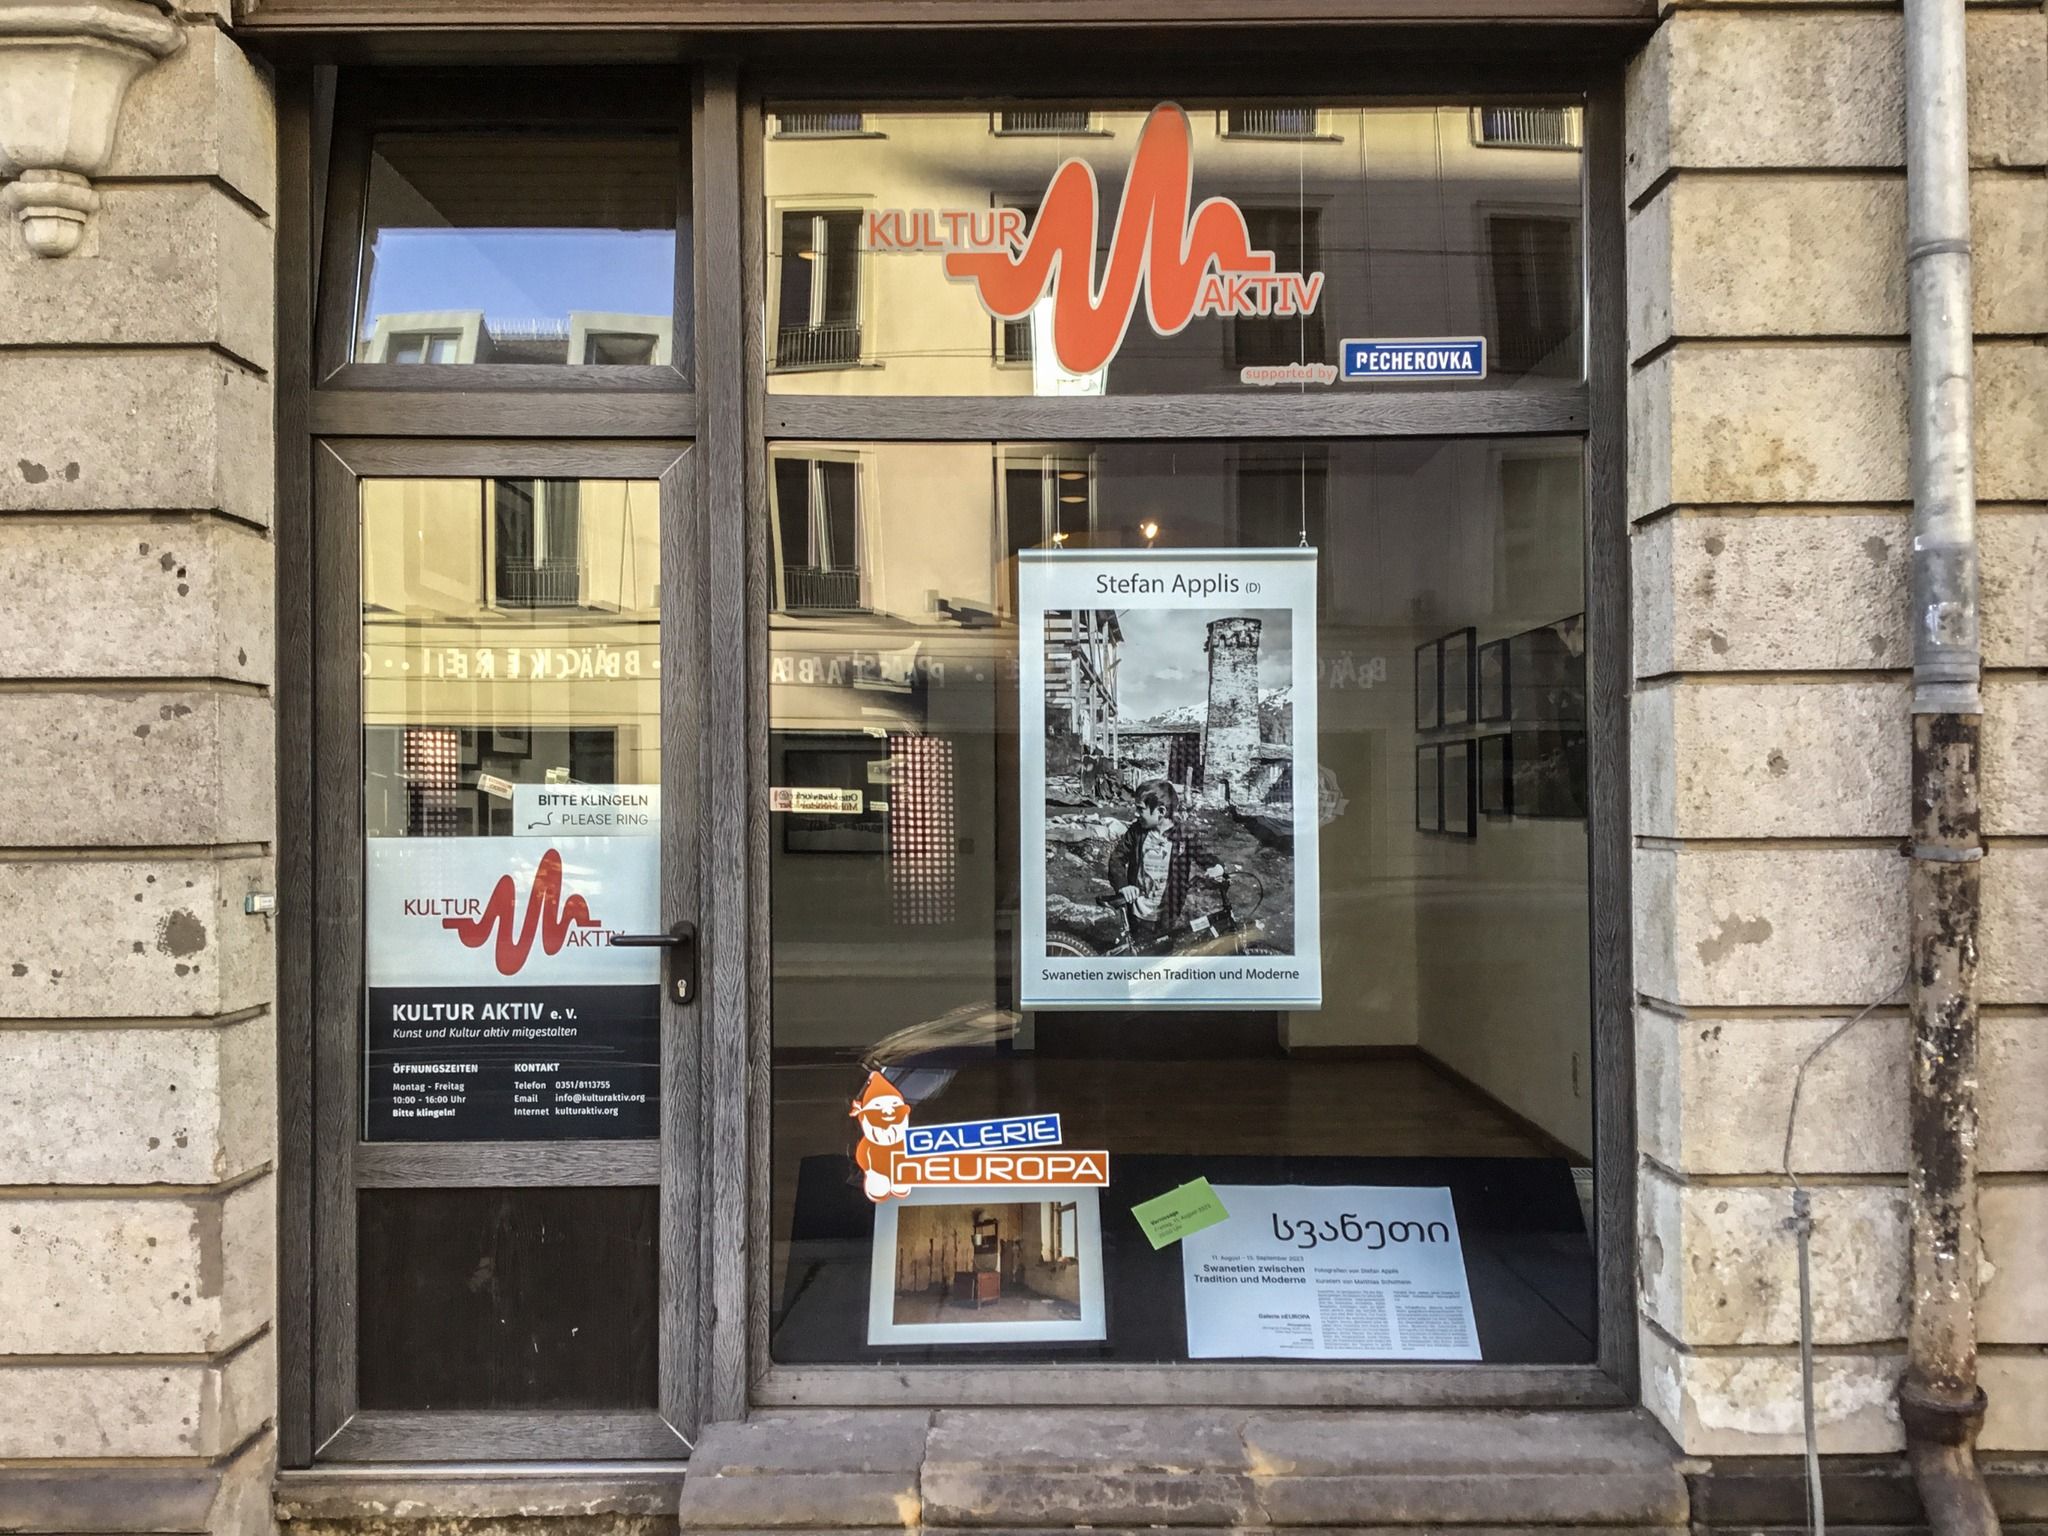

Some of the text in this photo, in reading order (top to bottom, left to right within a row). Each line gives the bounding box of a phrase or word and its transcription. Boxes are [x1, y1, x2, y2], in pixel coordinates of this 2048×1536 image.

[869, 210, 1026, 248] KULTUR
[1201, 273, 1323, 314] AKTIV
[1356, 350, 1473, 371] PECHEROVKA
[1246, 366, 1335, 385] supported by
[1096, 572, 1261, 599] Stefan Applis (D)
[538, 794, 648, 807] BITTE KLINGELN
[562, 813, 649, 826] PLEASE RING
[403, 898, 482, 915] KULTUR
[1041, 967, 1300, 982] Swanetien zwischen Tradition und Moderne
[392, 1002, 577, 1021] KULTUR AKTIV e. V.
[393, 1026, 577, 1040] Kunst und Kultur aktiv mitgestalten
[392, 1062, 479, 1074] ÖFFNUNGSZEITEN
[514, 1062, 560, 1072] KONTAKT
[392, 1081, 425, 1093] Montag
[434, 1081, 465, 1093] Freitag
[514, 1079, 611, 1090] Telefon 0351/8113755
[392, 1095, 416, 1104] 10:00
[425, 1095, 448, 1104] 16:00
[450, 1094, 466, 1104] Uhr
[514, 1092, 646, 1104] Email info@kulturaktiv.org
[392, 1107, 456, 1118] Bitte klingeln!
[514, 1105, 619, 1118] Internet kulturaktiv.org
[908, 1119, 1057, 1152] GALERIE
[896, 1156, 1104, 1182] nEUROPA
[1272, 1212, 1451, 1250] სვანეთი
[1203, 1263, 1306, 1273] Swanetien zwischen
[1194, 1274, 1307, 1284] Tradition und Moderne
